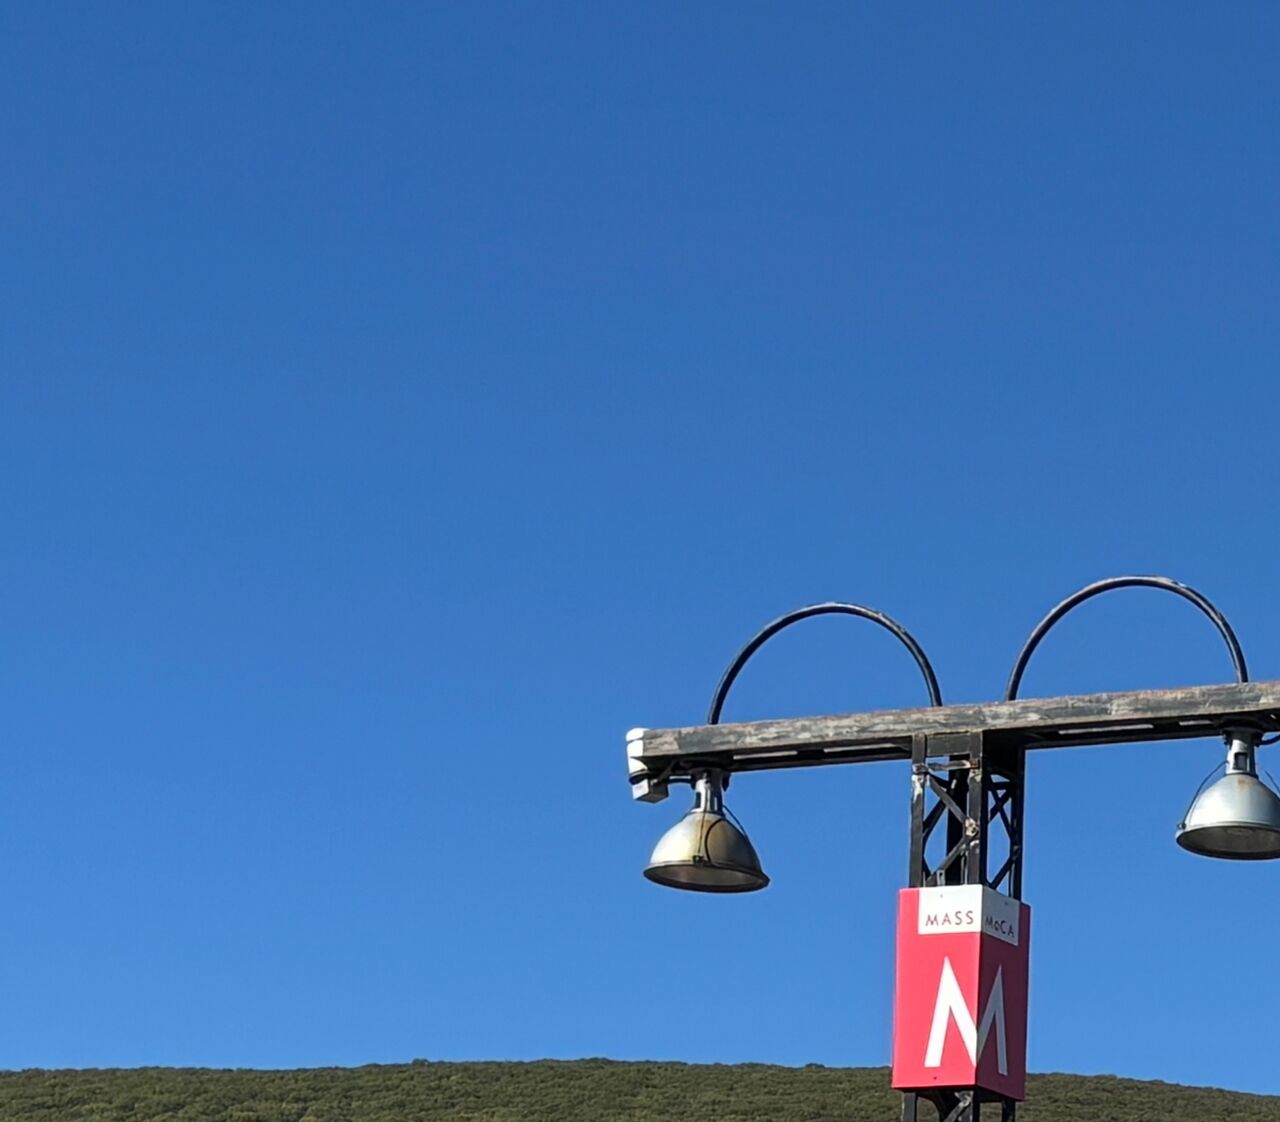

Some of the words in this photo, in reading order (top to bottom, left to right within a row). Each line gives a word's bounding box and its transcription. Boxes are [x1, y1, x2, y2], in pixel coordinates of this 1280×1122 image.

[925, 910, 974, 927] MASS
[985, 914, 1015, 938] MoCA
[924, 955, 1009, 1077] M
